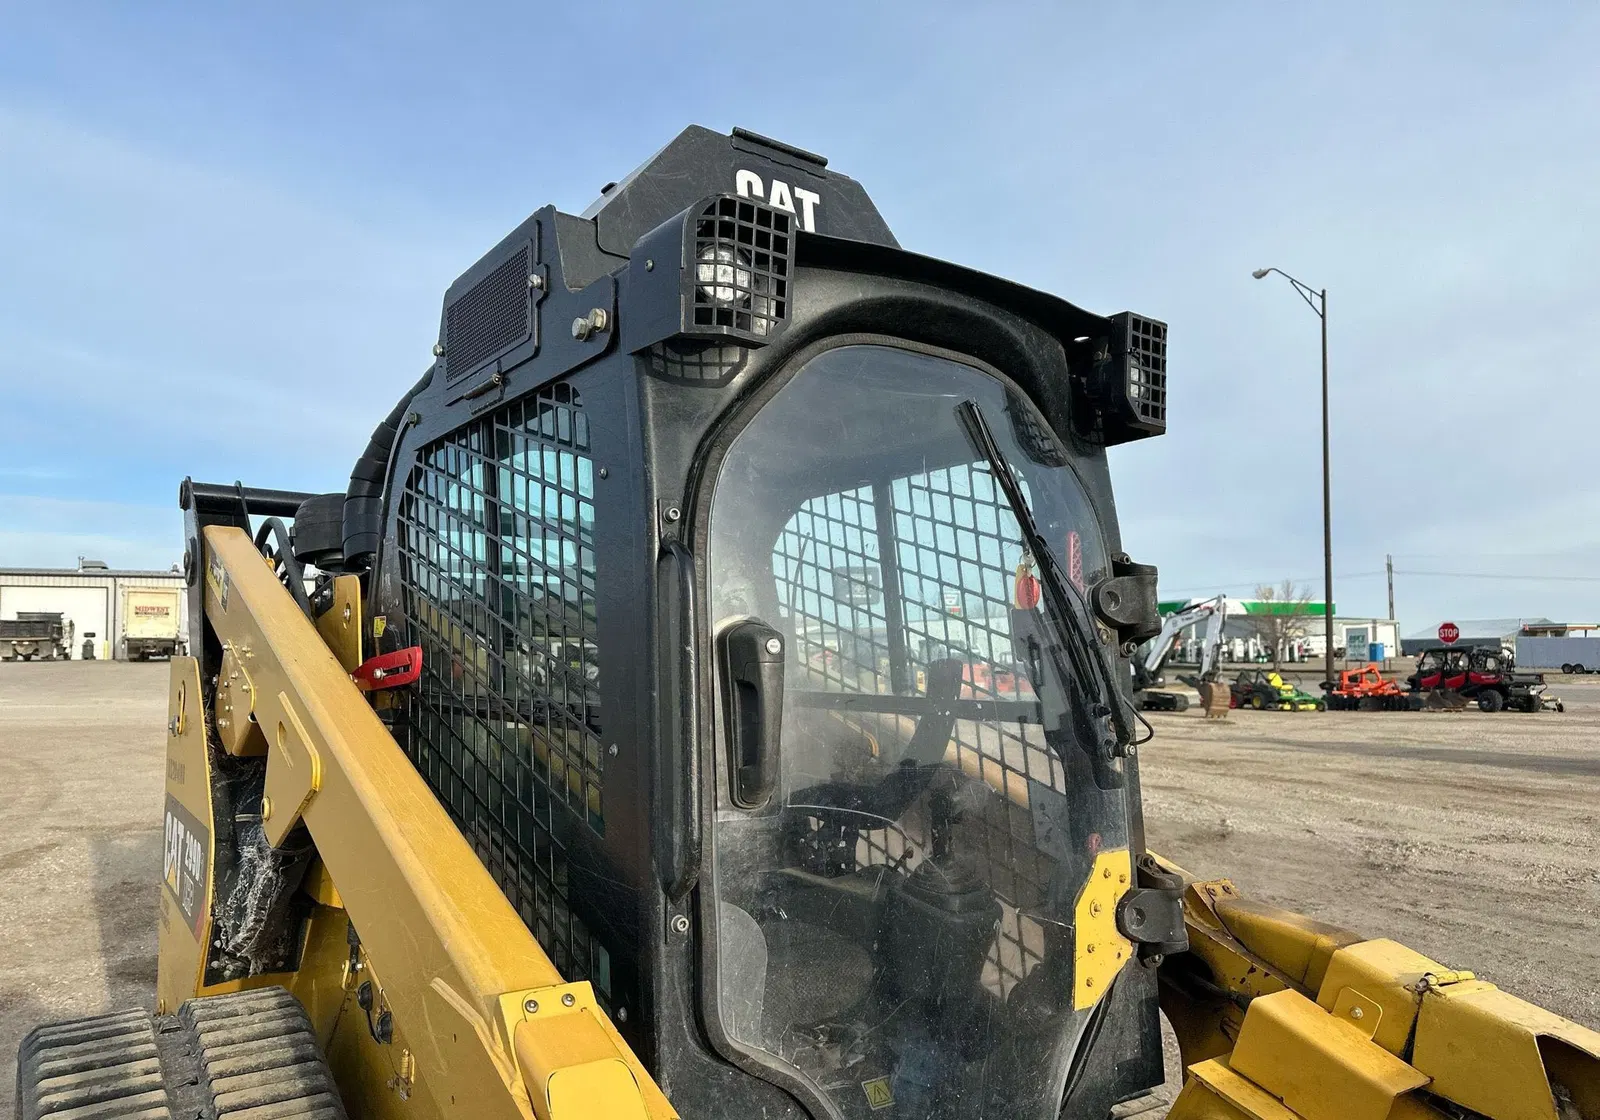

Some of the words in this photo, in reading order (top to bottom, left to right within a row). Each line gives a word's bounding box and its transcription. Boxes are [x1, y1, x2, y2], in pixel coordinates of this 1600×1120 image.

[134, 605, 170, 613] MIDWEST
[1439, 628, 1458, 638] STOP
[164, 811, 185, 897] CAT
